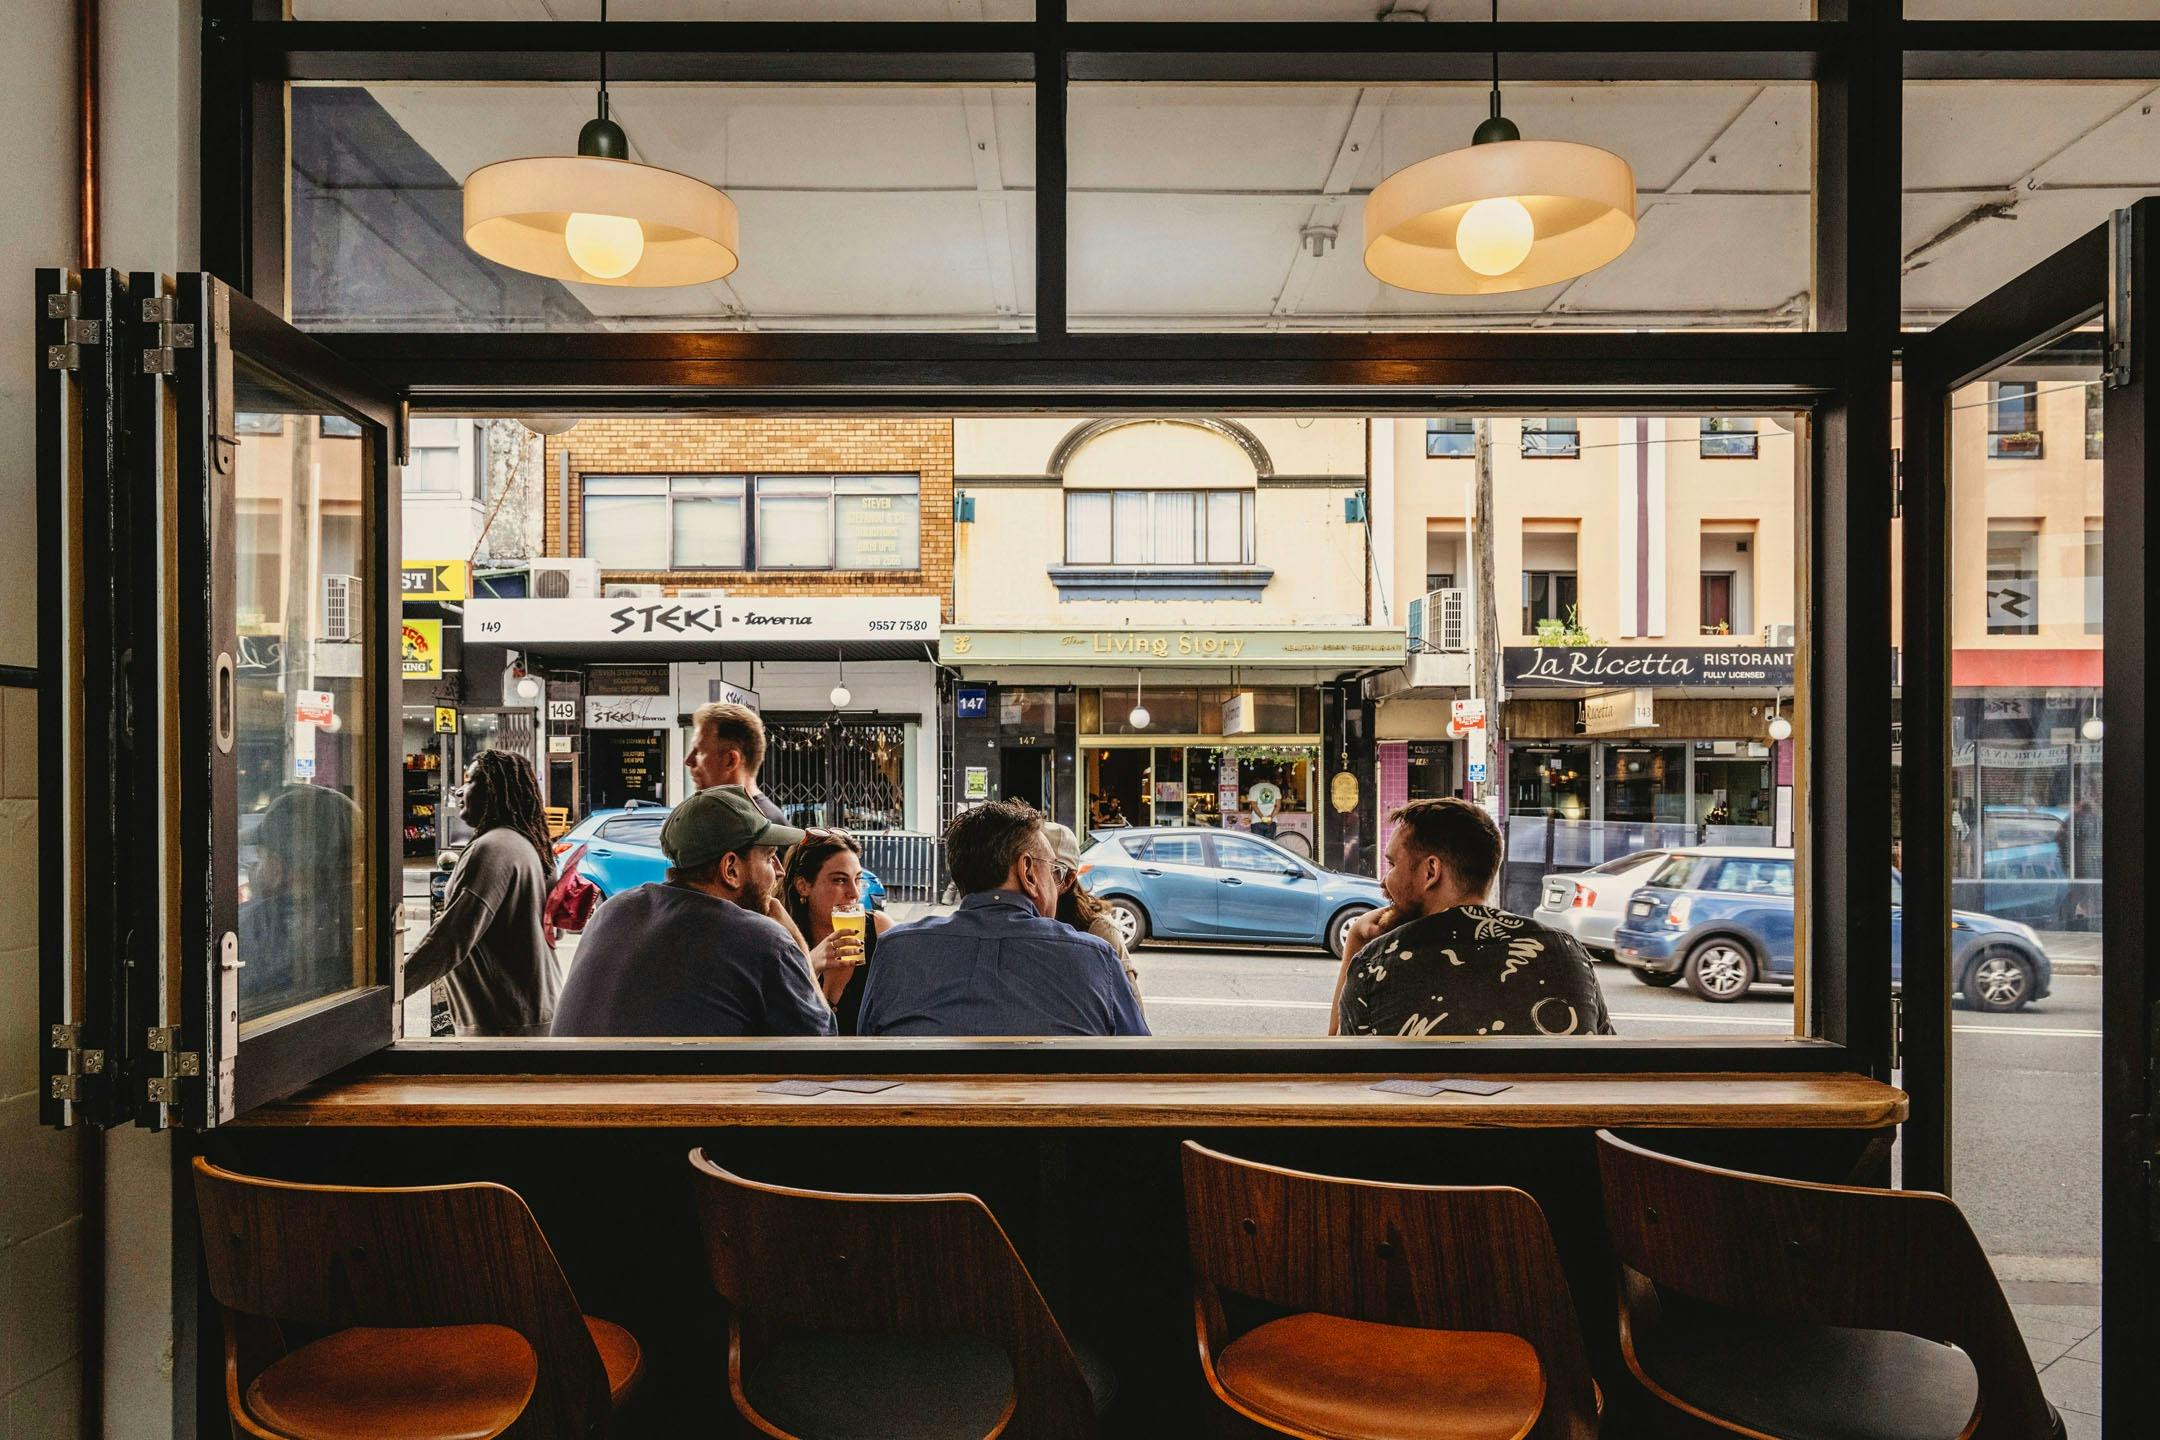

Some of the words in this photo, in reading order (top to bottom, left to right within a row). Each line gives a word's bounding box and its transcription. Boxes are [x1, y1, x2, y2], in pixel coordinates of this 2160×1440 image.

[744, 612, 813, 626] taverna
[868, 619, 897, 632] 9557
[899, 619, 929, 632] 7580
[480, 621, 502, 633] 149
[1092, 632, 1169, 658] Living
[1178, 632, 1245, 657] Story
[1567, 647, 1695, 677] Ricetta
[1703, 653, 1794, 666] RISTORANT
[1703, 671, 1727, 679] FULLY
[1728, 671, 1766, 679] LICENSED
[960, 697, 985, 710] 147
[550, 702, 575, 719] 149
[1586, 704, 1614, 721] Ricetta
[1636, 707, 1652, 719] 143
[1019, 736, 1037, 746] 147
